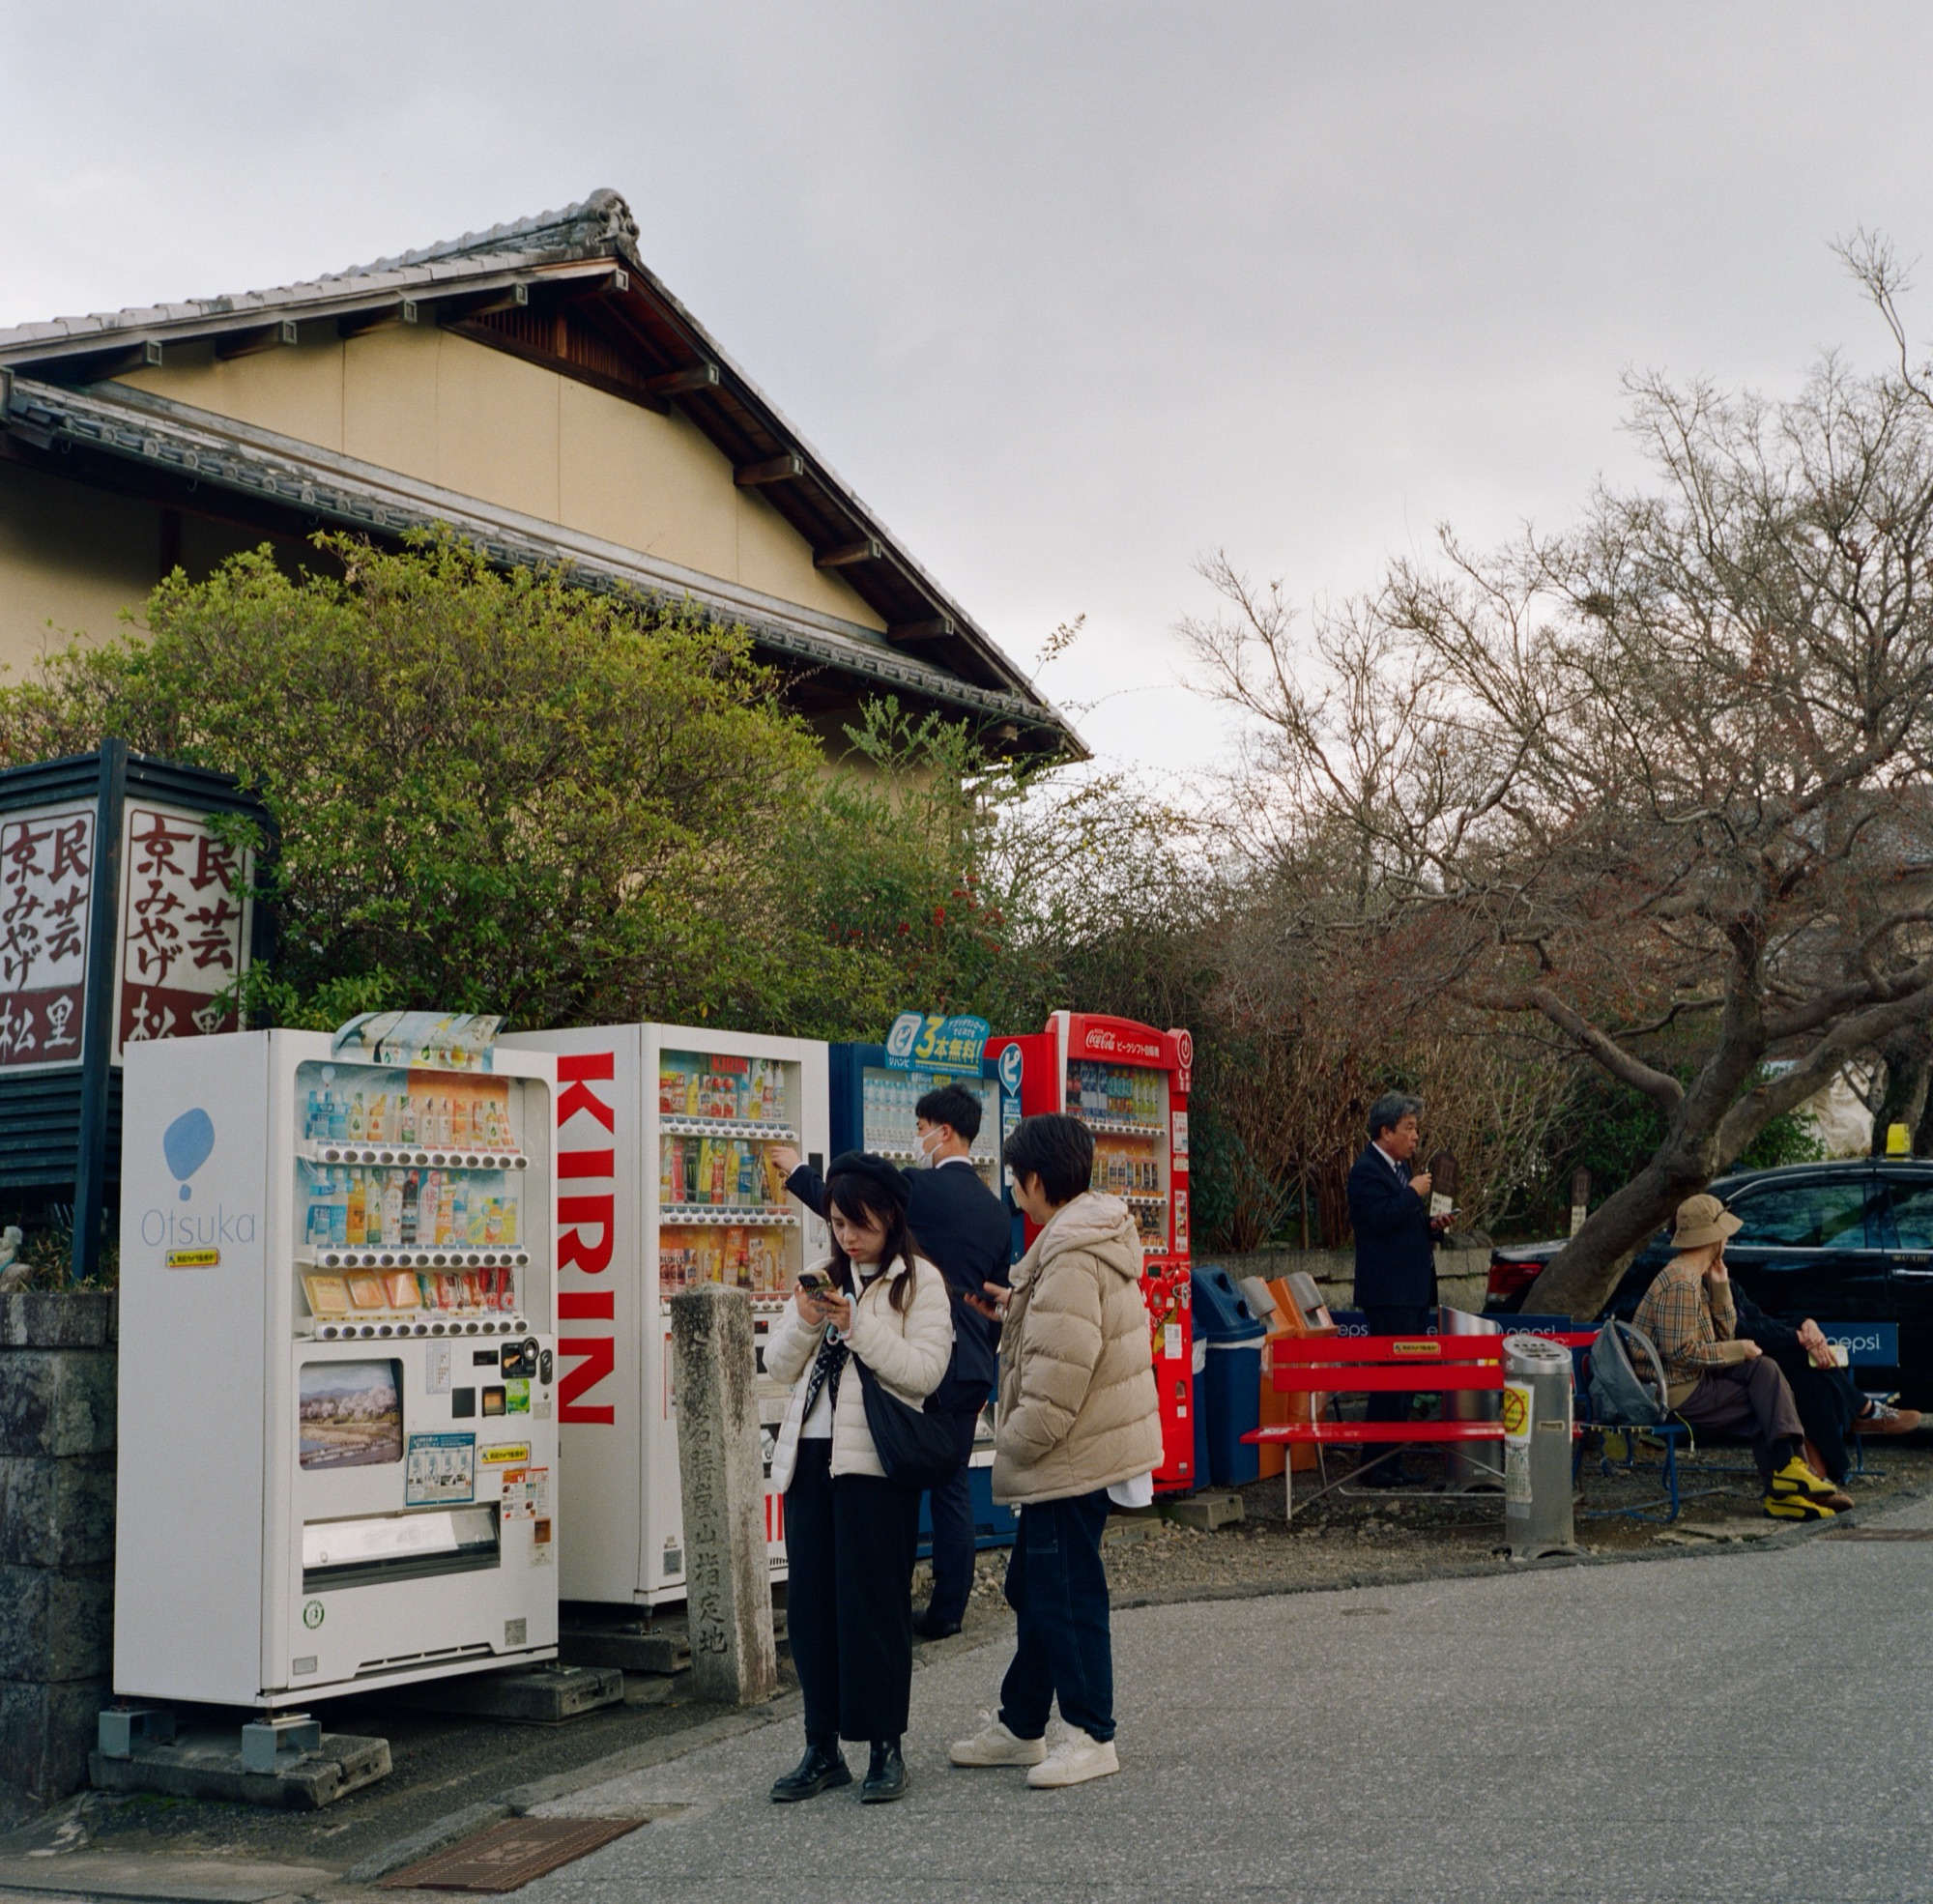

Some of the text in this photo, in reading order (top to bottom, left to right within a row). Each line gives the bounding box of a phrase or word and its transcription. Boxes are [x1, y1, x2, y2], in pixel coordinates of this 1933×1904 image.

[0, 822, 53, 990] 京みやげ
[43, 819, 90, 963] 民芸
[127, 814, 194, 987] 京みやげ
[184, 833, 240, 970] 民芸
[711, 1053, 749, 1075] KIRIN
[1004, 1050, 1021, 1082] ピ
[1116, 1040, 1160, 1057] ピークシフト自販機
[141, 1202, 255, 1246] Otsuka
[558, 1052, 615, 1425] KIRIN
[1338, 1323, 1369, 1338] eps
